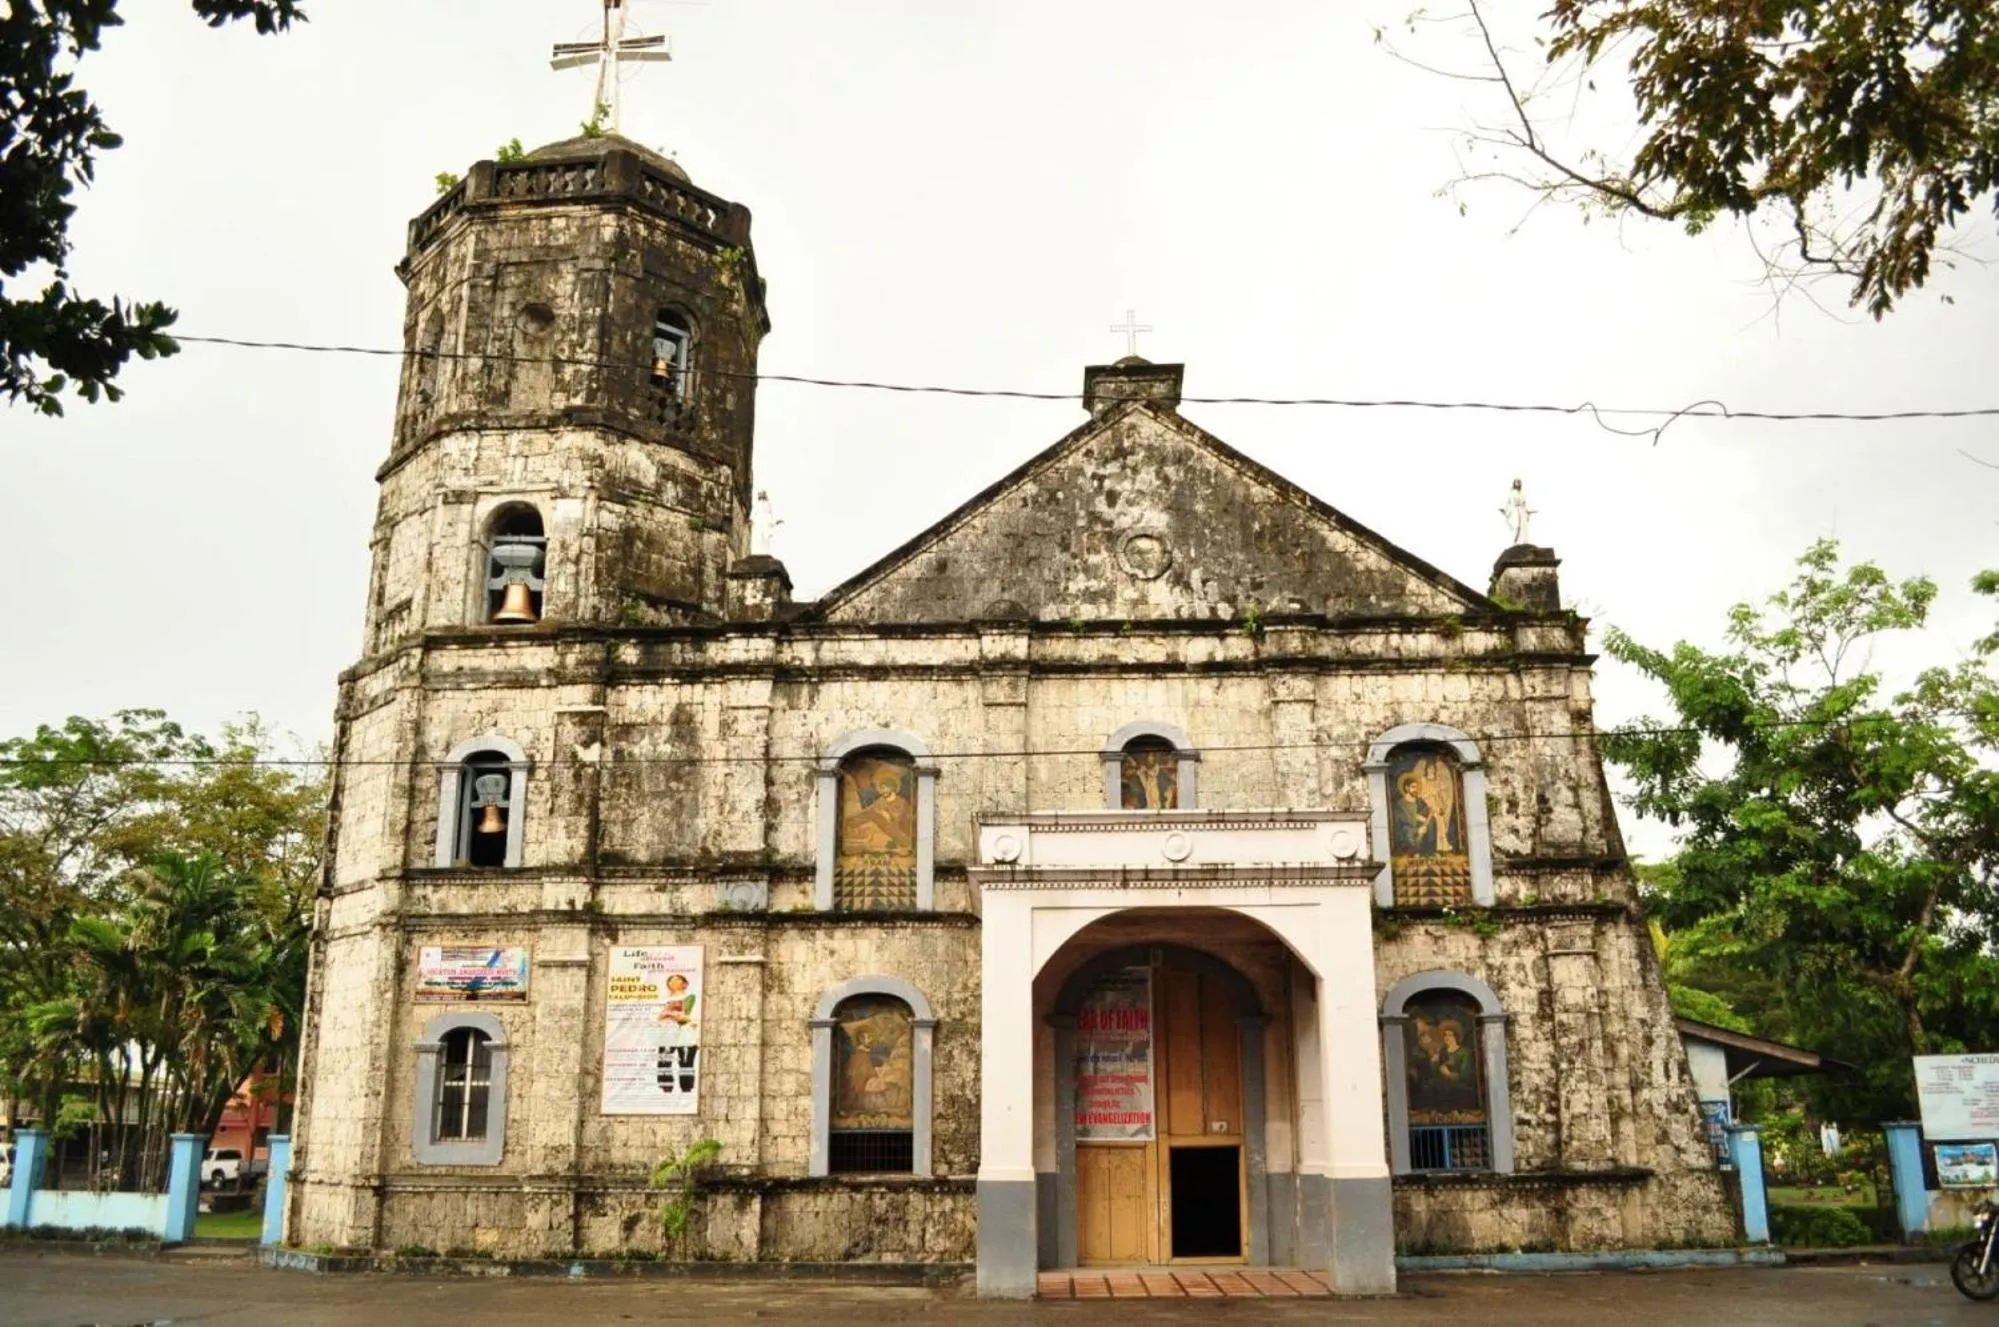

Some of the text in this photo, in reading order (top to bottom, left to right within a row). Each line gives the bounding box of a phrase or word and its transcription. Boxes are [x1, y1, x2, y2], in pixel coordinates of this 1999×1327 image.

[1100, 1008, 1112, 1031] OF
[1116, 1008, 1148, 1030] FAITH
[1088, 1111, 1151, 1125] EVANGELIZATION
